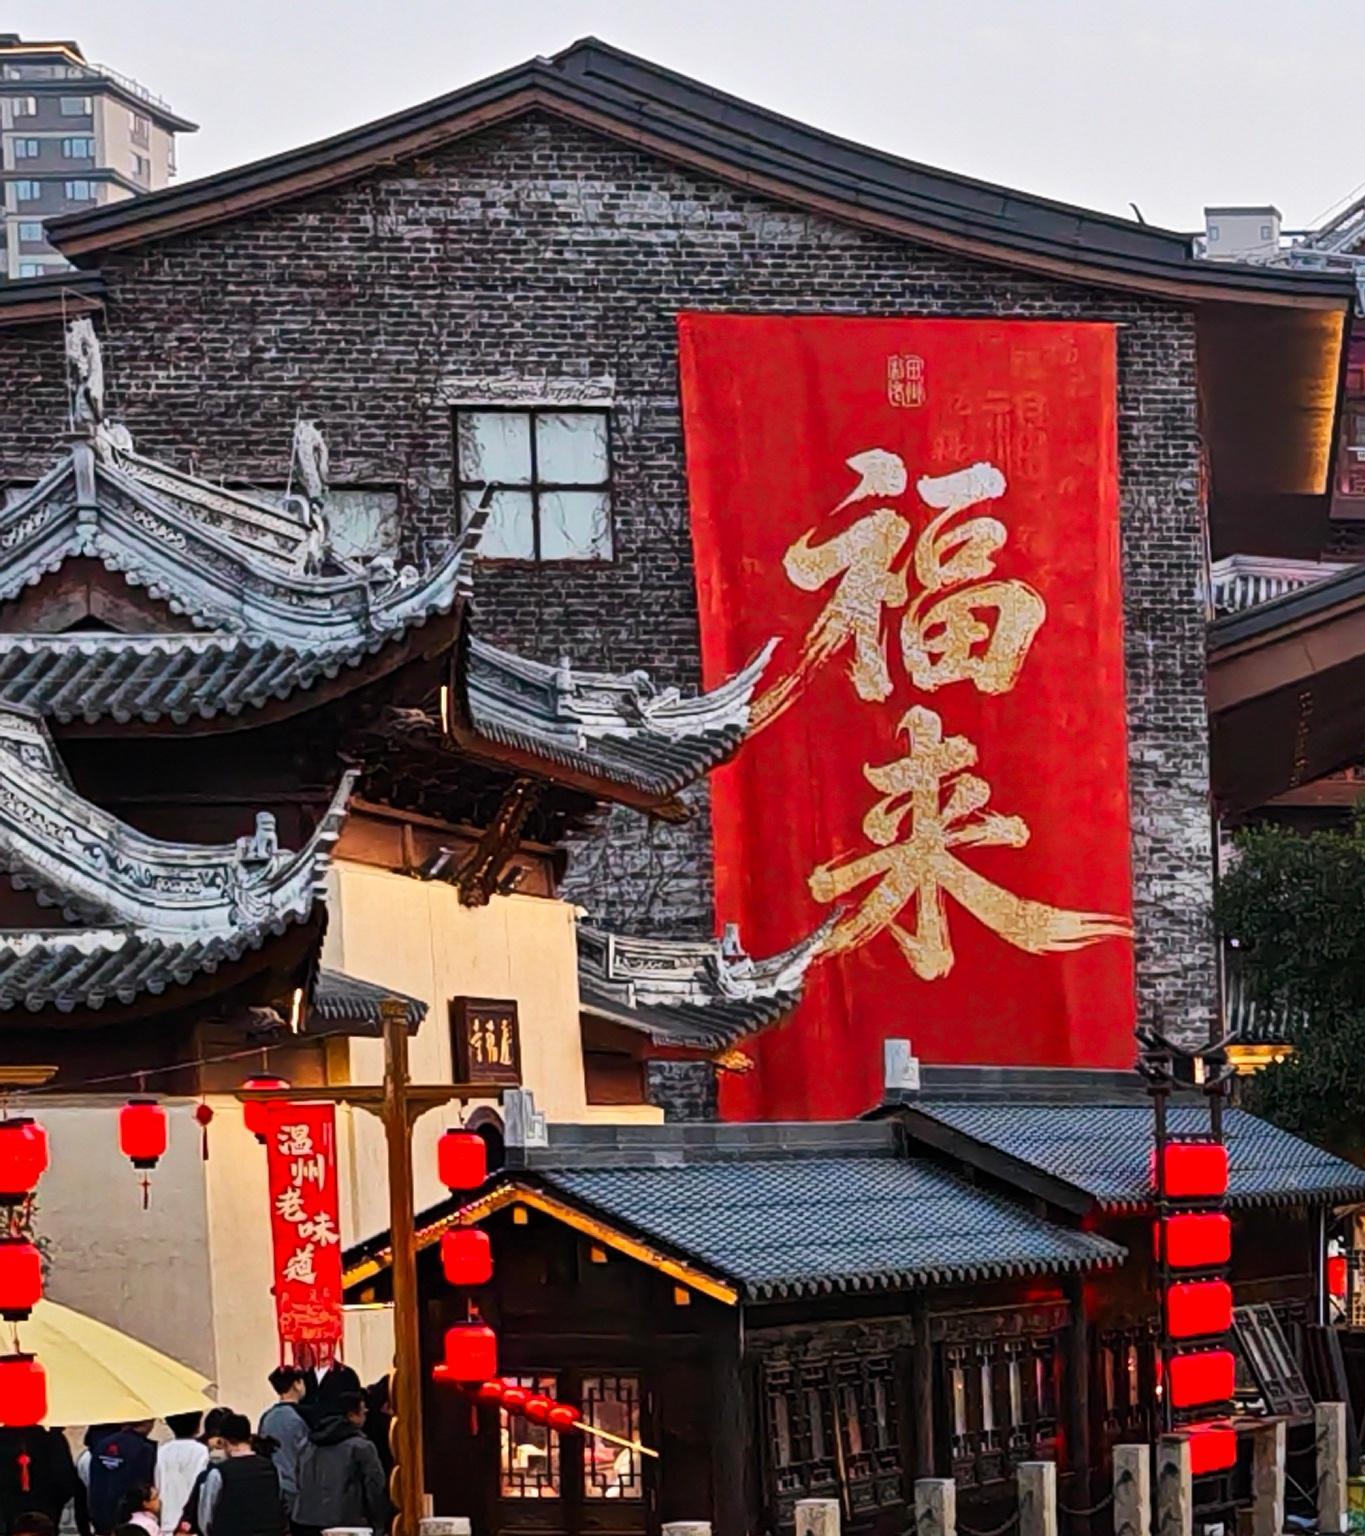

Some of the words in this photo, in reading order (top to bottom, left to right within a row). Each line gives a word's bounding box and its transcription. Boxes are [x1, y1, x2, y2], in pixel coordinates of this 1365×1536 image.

[748, 447, 1133, 981] 福来
[276, 1124, 340, 1285] 温州老味道
